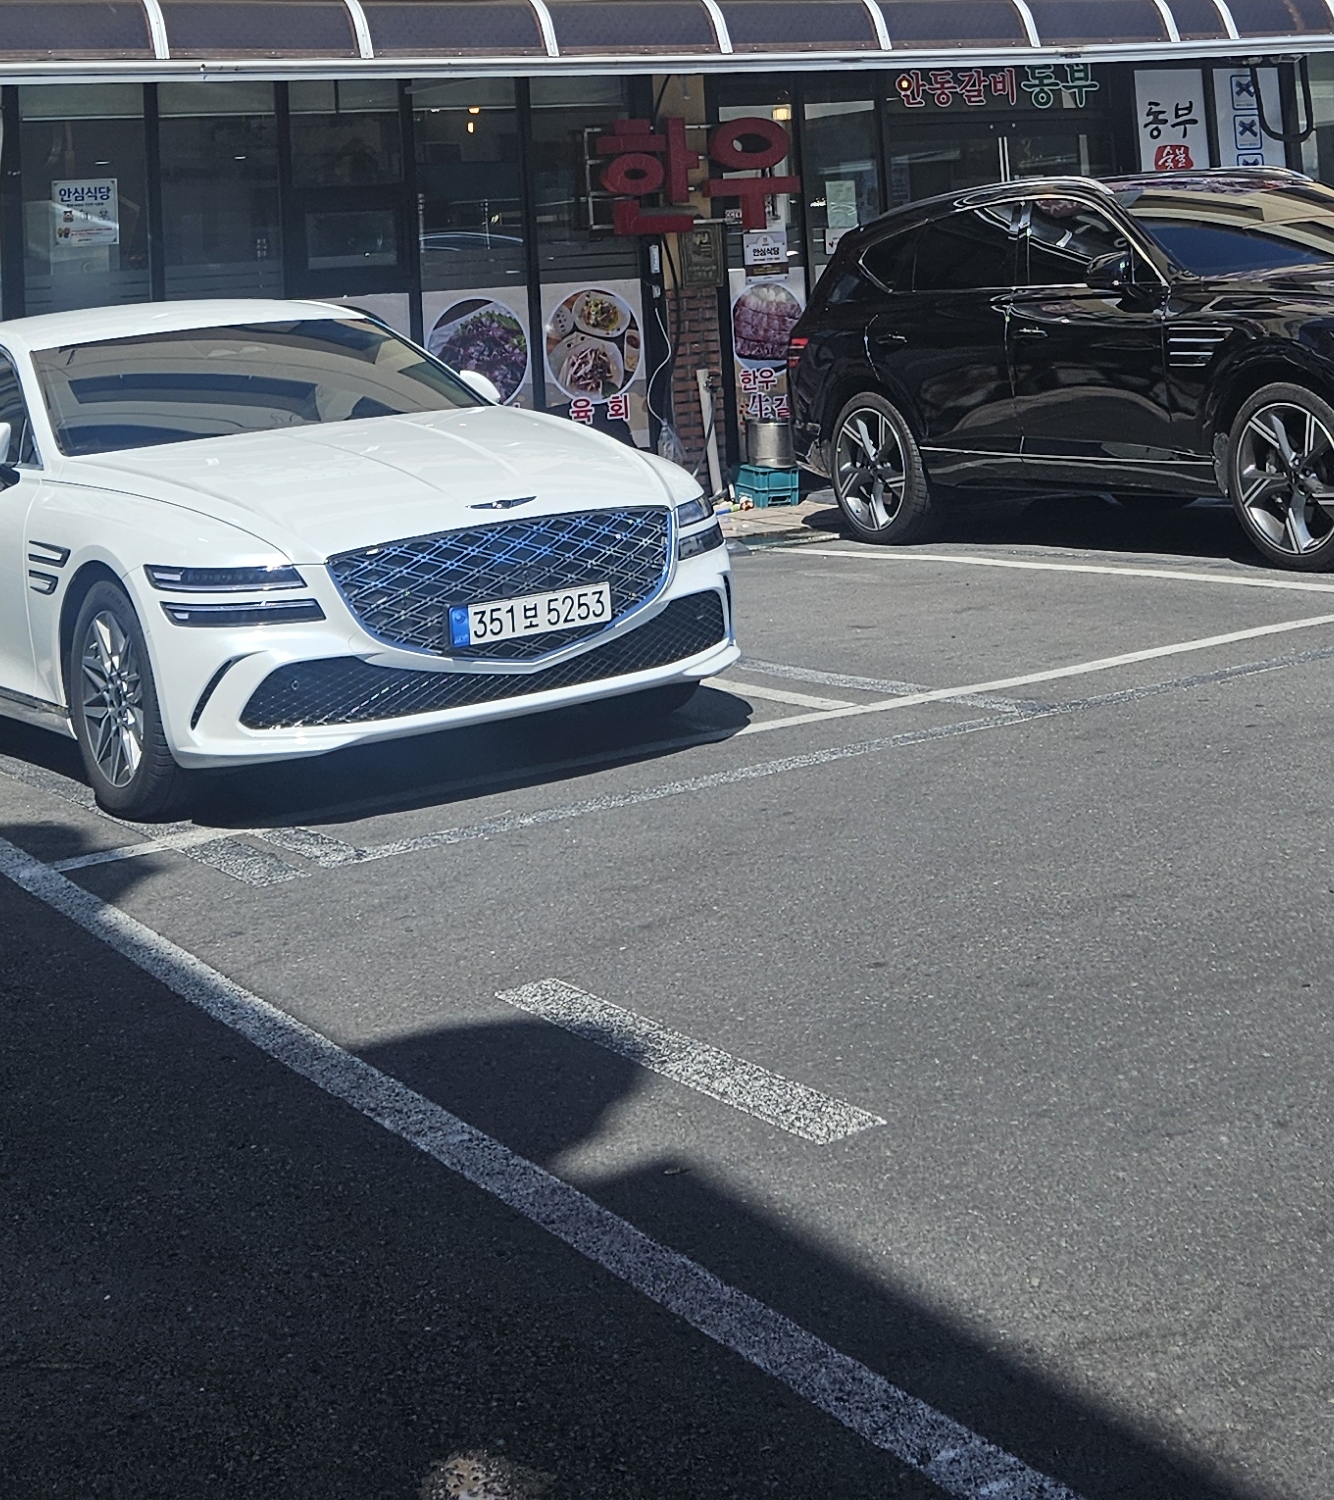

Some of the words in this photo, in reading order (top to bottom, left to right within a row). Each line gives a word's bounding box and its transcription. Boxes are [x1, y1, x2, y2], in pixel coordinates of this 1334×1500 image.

[895, 69, 1017, 108] 안동갈비
[1143, 101, 1198, 140] 동부
[59, 186, 111, 202] 안심식당
[596, 117, 801, 235] 한우
[741, 369, 776, 392] 한우
[473, 603, 539, 639] 351보
[547, 590, 606, 627] 5253
